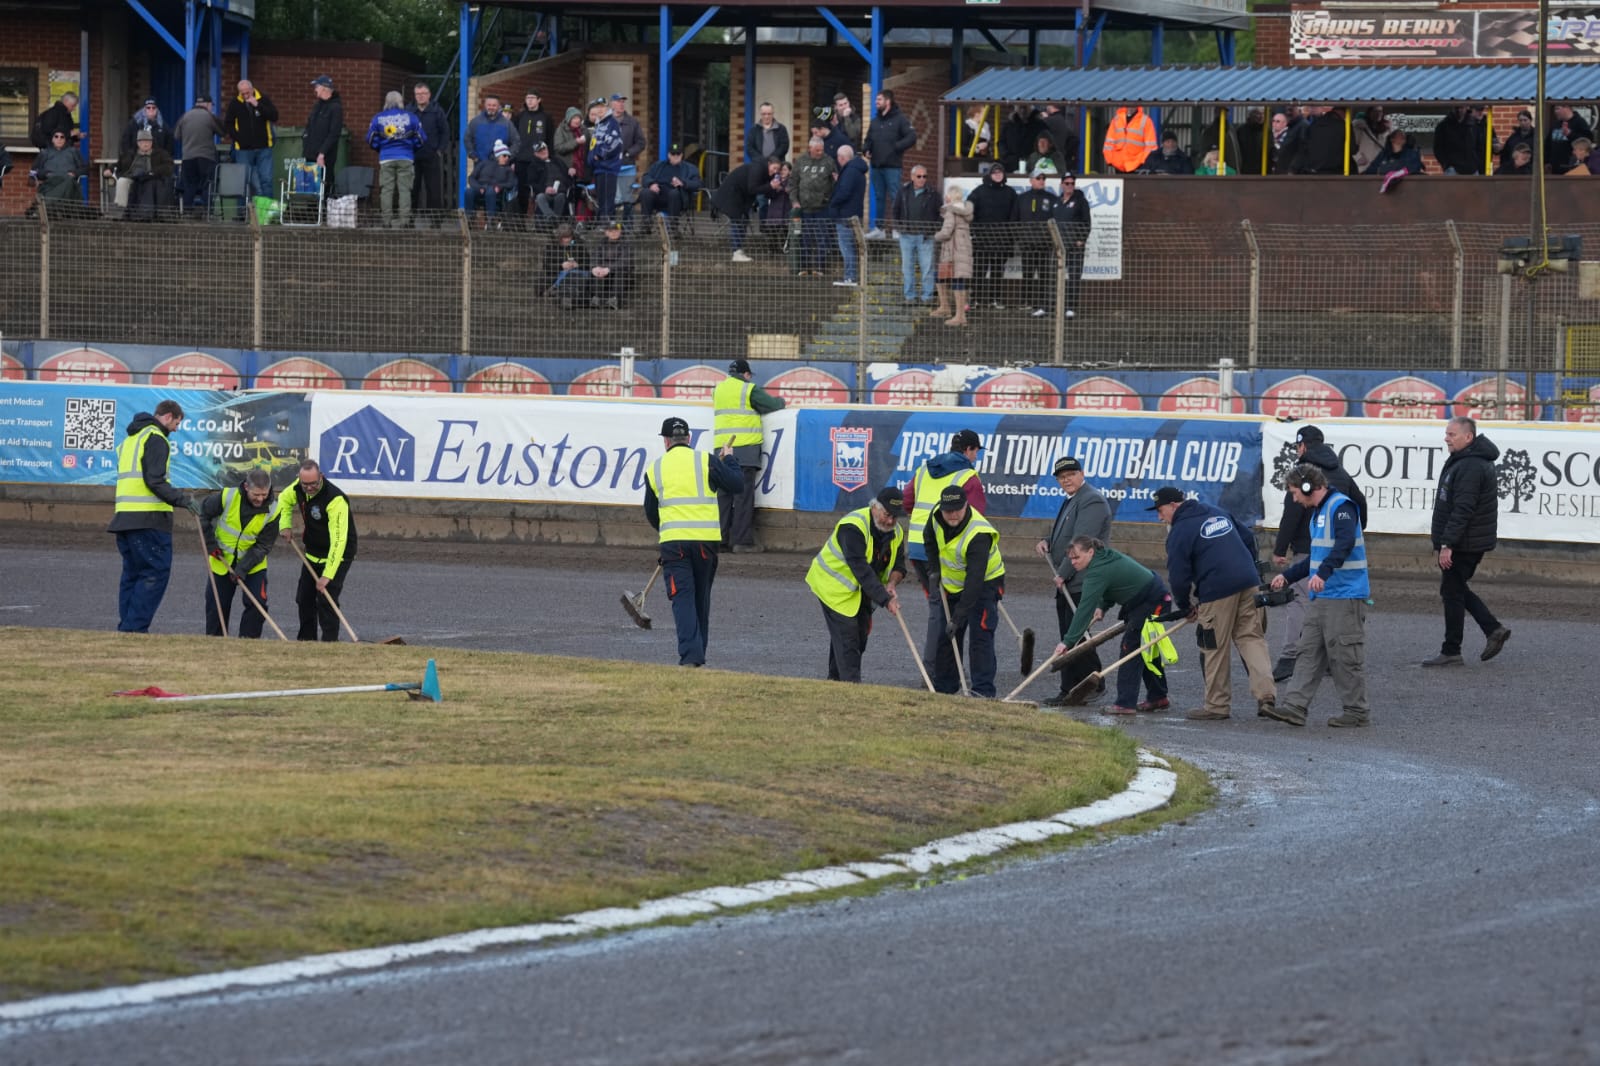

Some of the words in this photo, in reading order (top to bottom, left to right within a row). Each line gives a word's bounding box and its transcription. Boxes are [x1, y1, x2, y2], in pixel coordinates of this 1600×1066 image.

[1304, 19, 1376, 36] CHRIS
[1382, 19, 1461, 35] BERRY
[56, 361, 114, 377] KENT
[168, 366, 223, 382] KENT
[272, 371, 328, 387] KENT
[380, 373, 434, 389] KENT
[585, 379, 639, 394] KEN
[675, 379, 722, 394] KEN
[779, 381, 832, 397] KENT
[991, 384, 1043, 400] KENT
[13, 398, 44, 406] Medical
[1074, 391, 1126, 406] KENT
[1176, 392, 1220, 407] KEN
[1277, 390, 1330, 405] KENT
[16, 418, 53, 428] Transport
[8, 438, 21, 446] Aid
[22, 439, 52, 449] Training
[183, 441, 244, 458] 807070
[16, 458, 53, 468] Transport
[329, 436, 408, 477] R.N.
[421, 419, 647, 491] Euston
[897, 431, 1001, 474] IPSH
[1003, 434, 1071, 476] TOWN
[1074, 437, 1177, 481] FOOTBALL
[1181, 440, 1242, 483] CLUB
[1325, 443, 1443, 481] COTT
[1540, 450, 1600, 488] SC
[1365, 486, 1440, 510] PERTI
